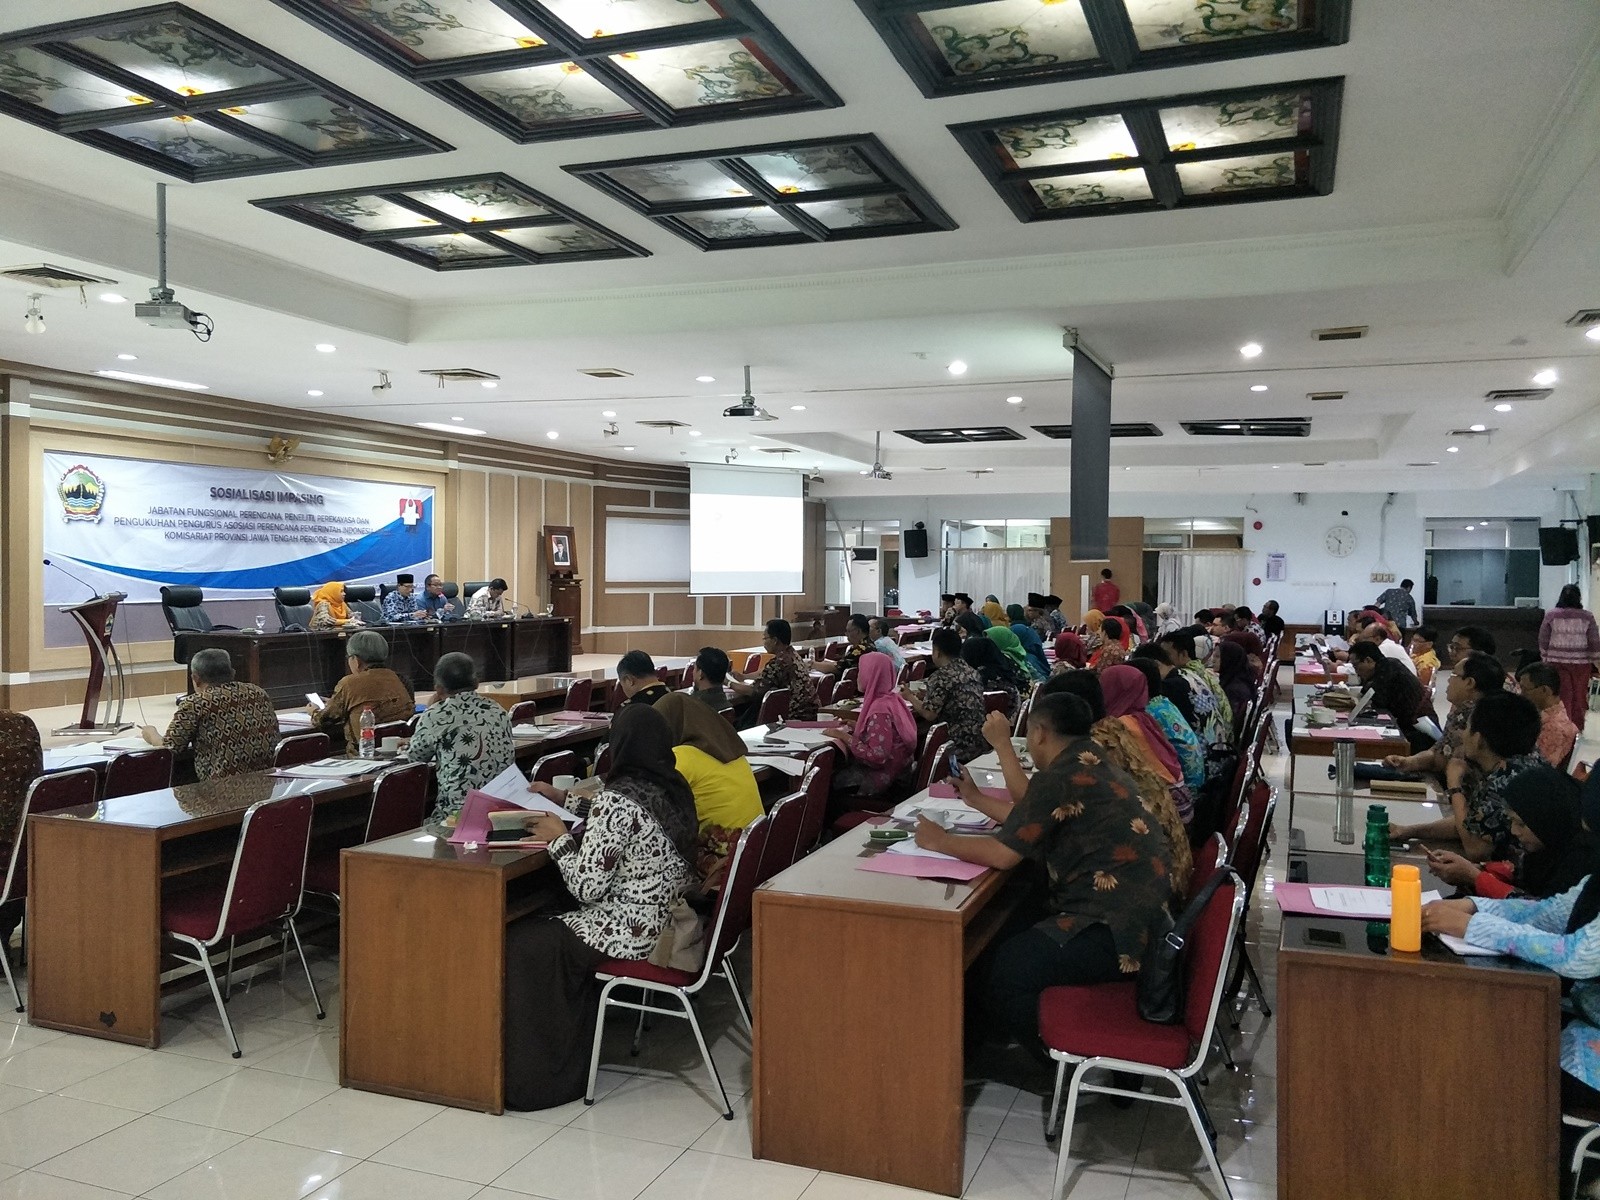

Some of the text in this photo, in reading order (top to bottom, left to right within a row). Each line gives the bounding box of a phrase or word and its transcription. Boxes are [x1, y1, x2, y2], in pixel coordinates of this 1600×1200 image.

[210, 487, 274, 501] SOSIALISASI
[148, 506, 185, 516] JABATAN
[187, 508, 238, 518] FUNGSIONAL
[317, 515, 357, 524] PEREKAYASA
[357, 517, 370, 525] DAN
[113, 517, 176, 528] PENGUKUHAN
[178, 520, 222, 529] PENGURUS
[224, 521, 255, 531] ASOSIASI
[257, 523, 299, 532] PERENCANA
[300, 525, 341, 533] PEMERINTAH
[164, 531, 213, 541] KOMISARIAT
[215, 533, 248, 542] PROVINSI
[249, 534, 270, 542] JAWA
[271, 535, 298, 543] TENGAH
[300, 536, 328, 544] PERIODE
